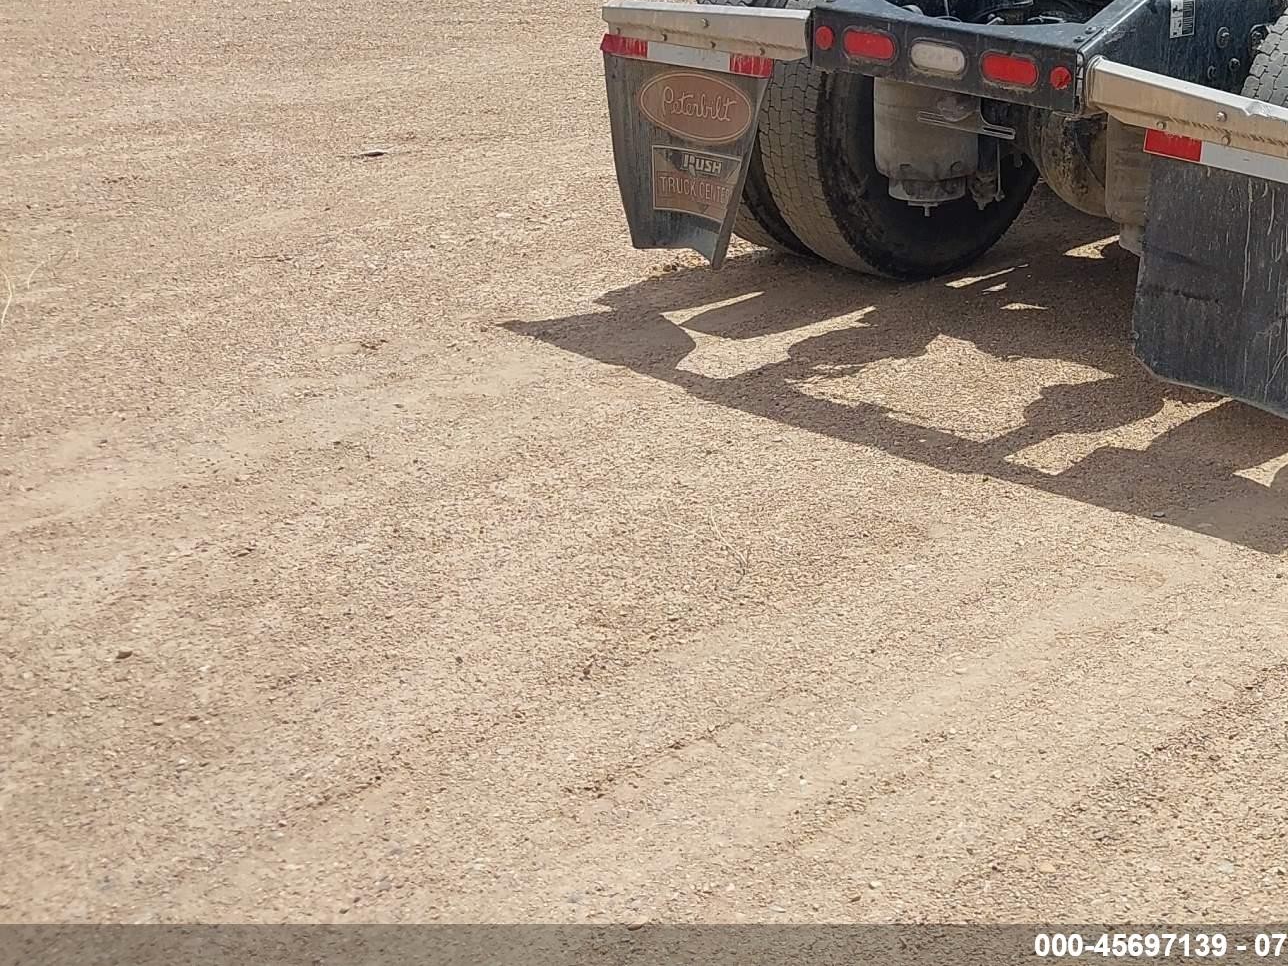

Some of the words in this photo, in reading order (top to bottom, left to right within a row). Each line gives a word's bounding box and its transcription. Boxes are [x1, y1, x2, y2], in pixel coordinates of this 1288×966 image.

[662, 86, 738, 122] Peterbilt
[682, 153, 722, 176] RUSH
[660, 176, 698, 196] TRUCK
